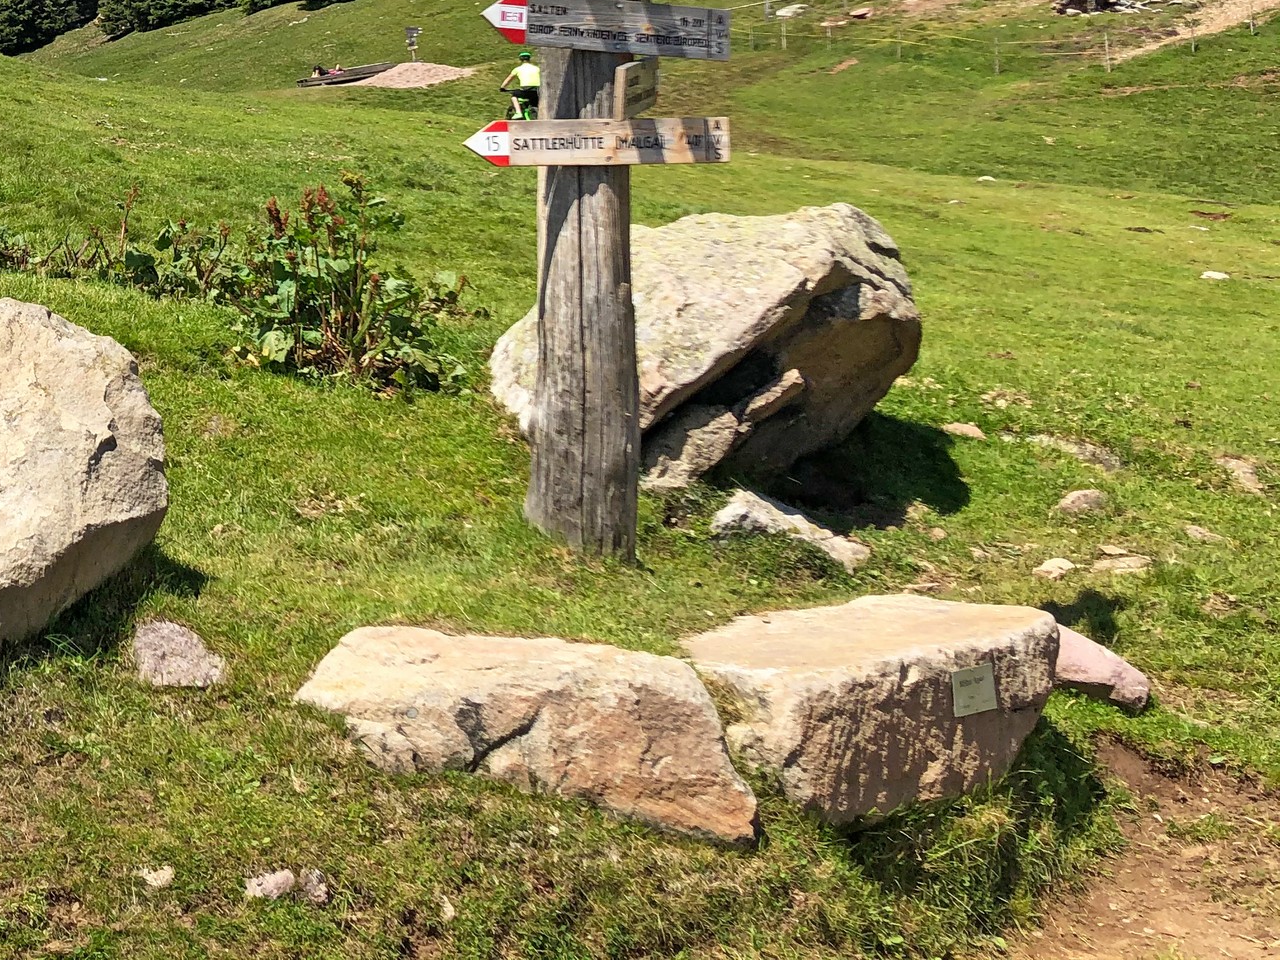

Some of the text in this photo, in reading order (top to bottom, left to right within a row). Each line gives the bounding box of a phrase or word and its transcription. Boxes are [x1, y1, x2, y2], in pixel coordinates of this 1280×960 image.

[529, 3, 569, 16] SALTEN
[486, 135, 501, 152] 15
[513, 133, 605, 151] SATTLERHÜTTE
